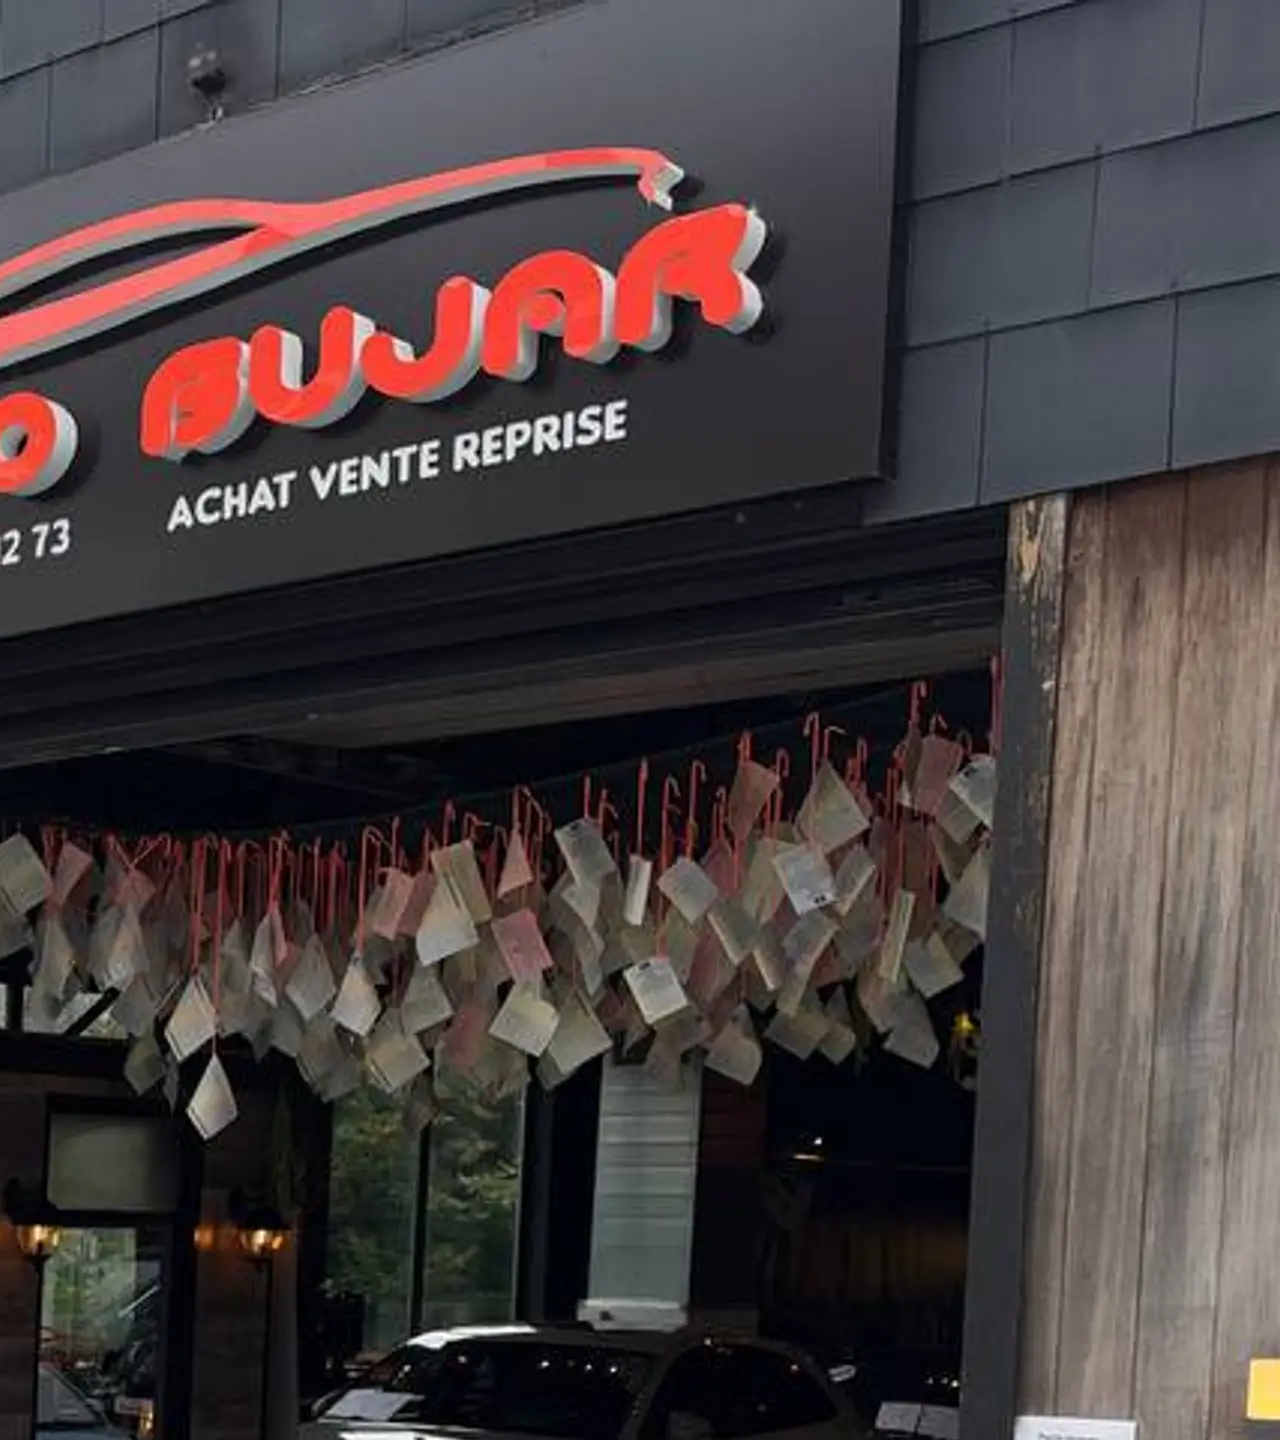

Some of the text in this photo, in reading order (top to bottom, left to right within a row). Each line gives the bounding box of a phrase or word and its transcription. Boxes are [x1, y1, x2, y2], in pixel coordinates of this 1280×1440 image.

[141, 203, 766, 461] BUJAR
[166, 400, 629, 532] ACHAT VENTE REPRISE
[31, 518, 71, 557] 73
